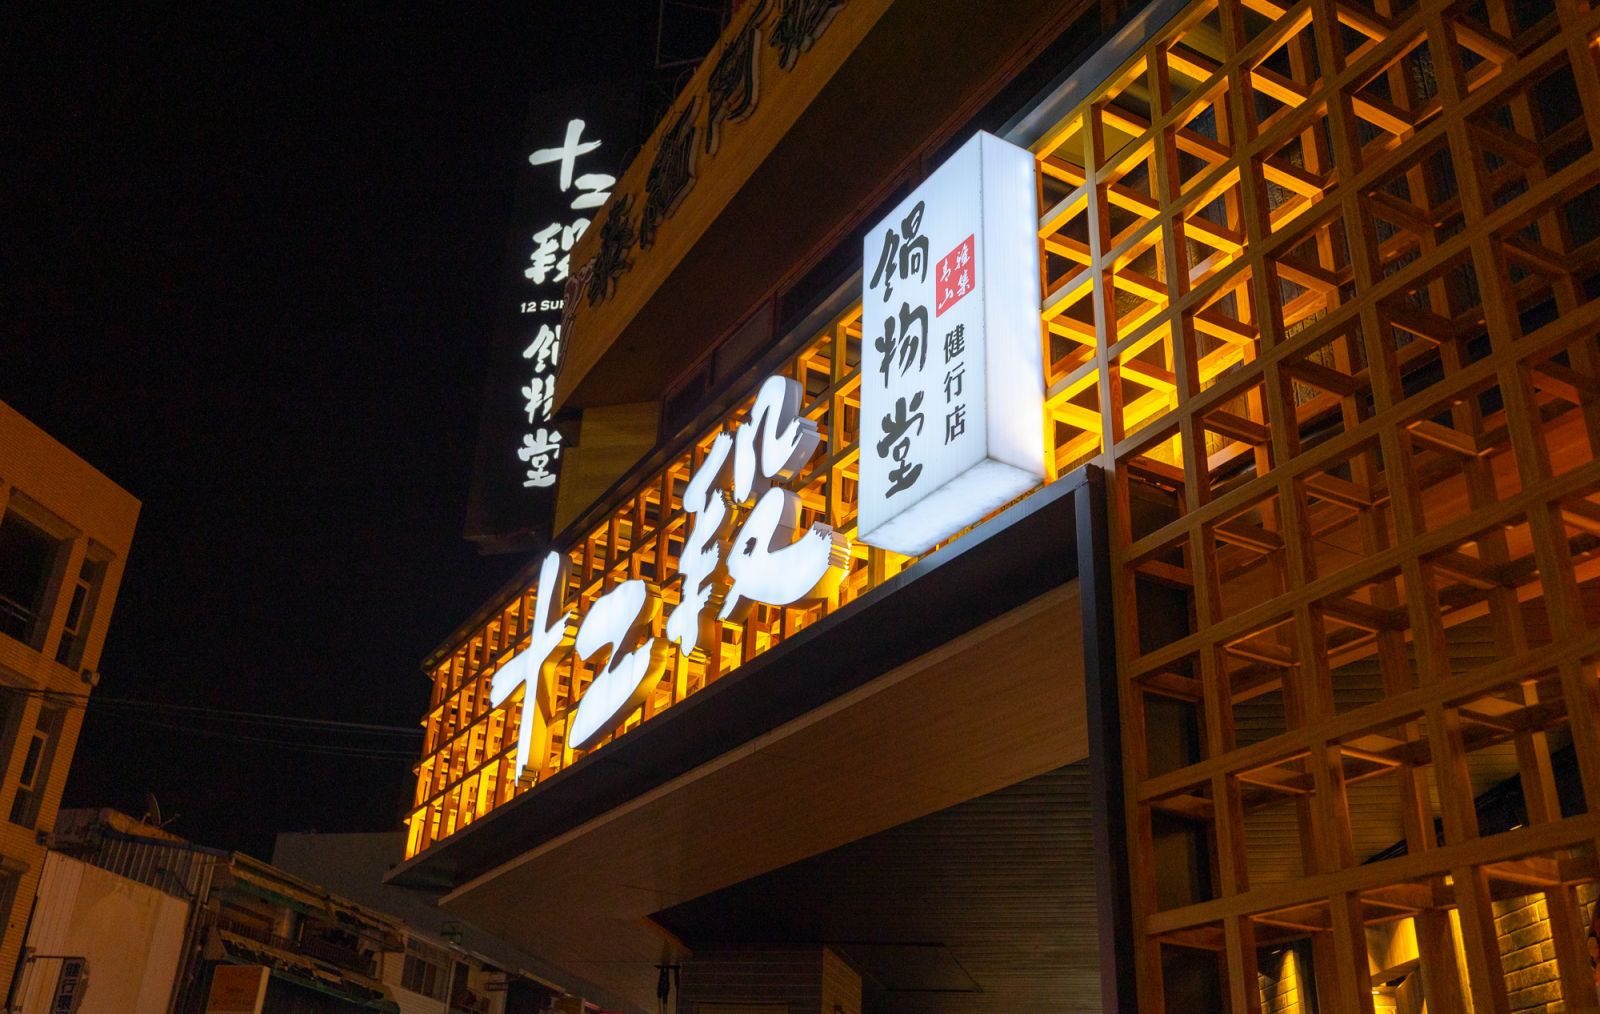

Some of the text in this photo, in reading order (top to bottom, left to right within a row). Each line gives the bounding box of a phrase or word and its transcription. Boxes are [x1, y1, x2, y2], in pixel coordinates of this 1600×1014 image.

[520, 301, 537, 313] 12
[869, 200, 929, 499] 鍋物堂
[943, 323, 966, 445] 健行店
[490, 374, 840, 787] 十二段
